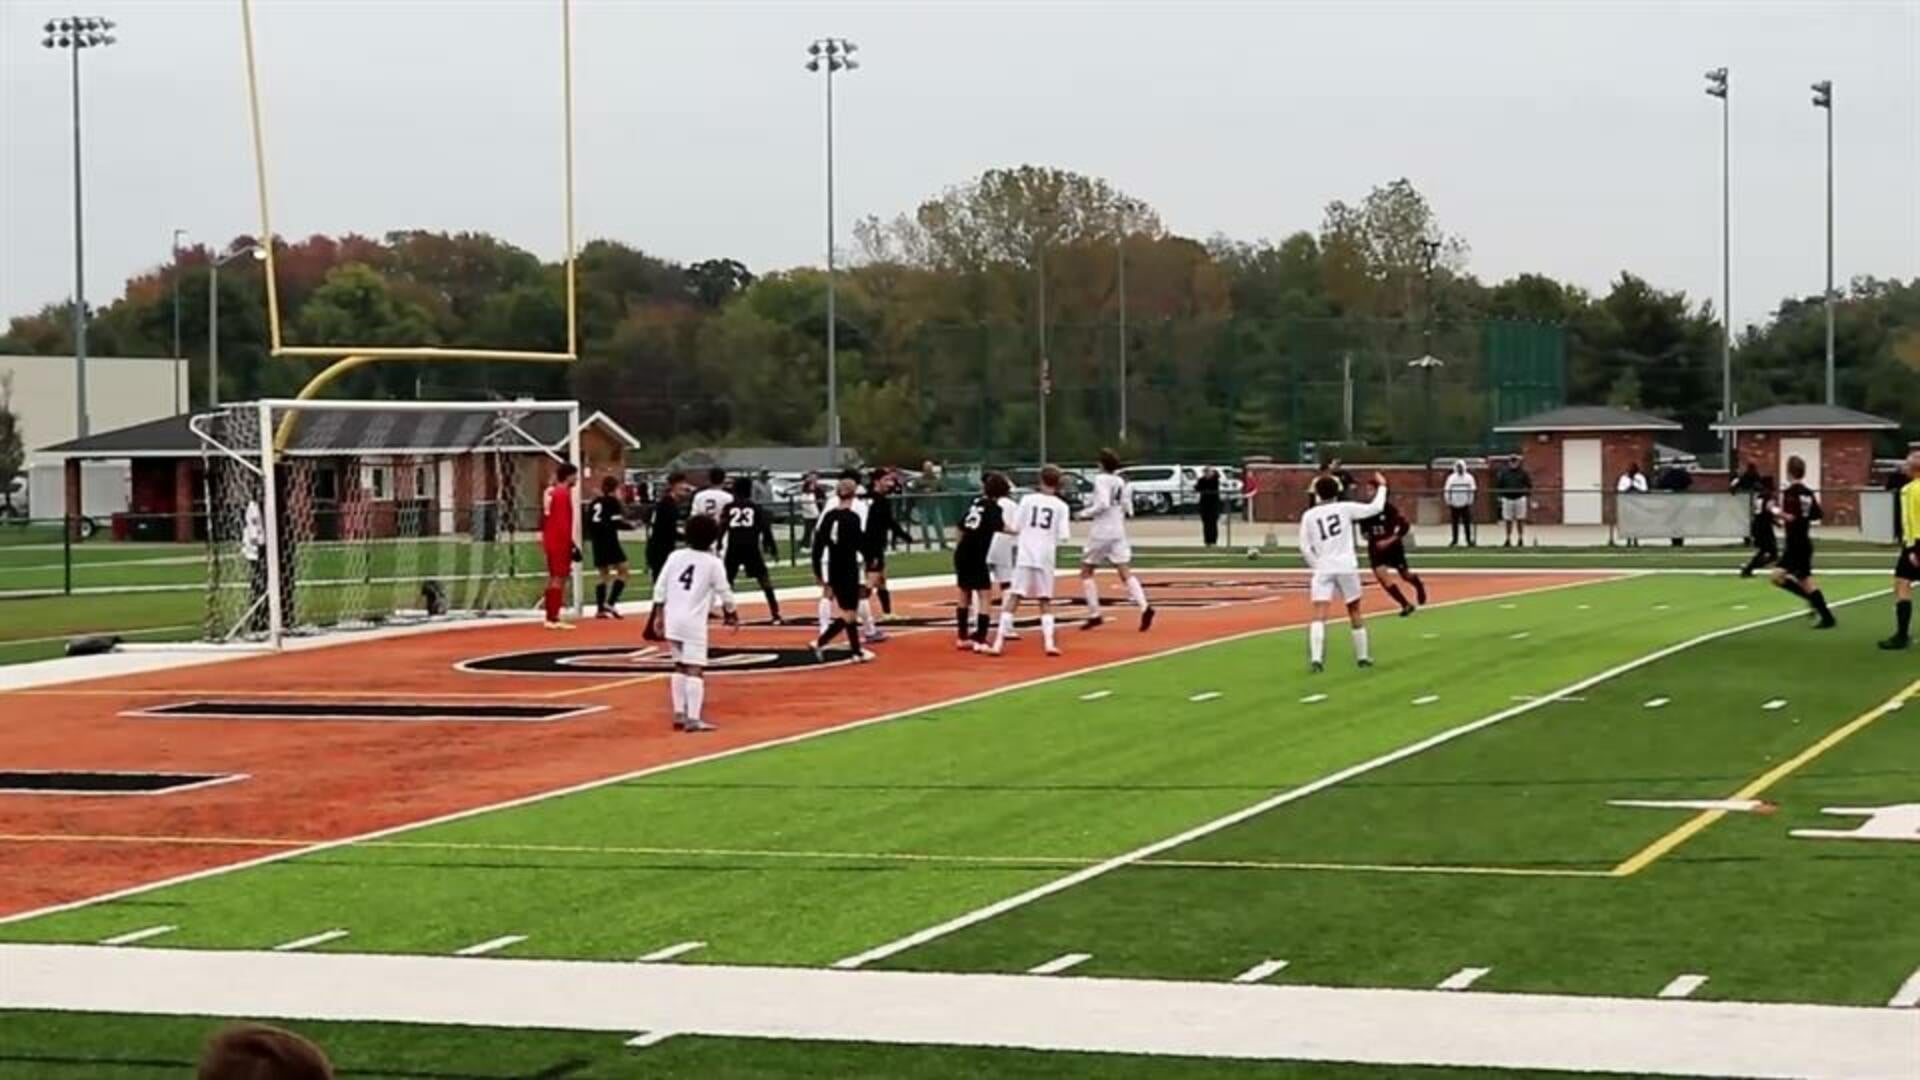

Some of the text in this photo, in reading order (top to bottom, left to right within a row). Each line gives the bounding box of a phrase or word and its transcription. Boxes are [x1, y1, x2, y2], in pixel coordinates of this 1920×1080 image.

[591, 502, 603, 523] 2
[704, 498, 718, 515] 2
[728, 507, 755, 528] 23
[1029, 506, 1054, 530] 13
[1316, 513, 1342, 541] 12
[678, 564, 696, 591] 4
